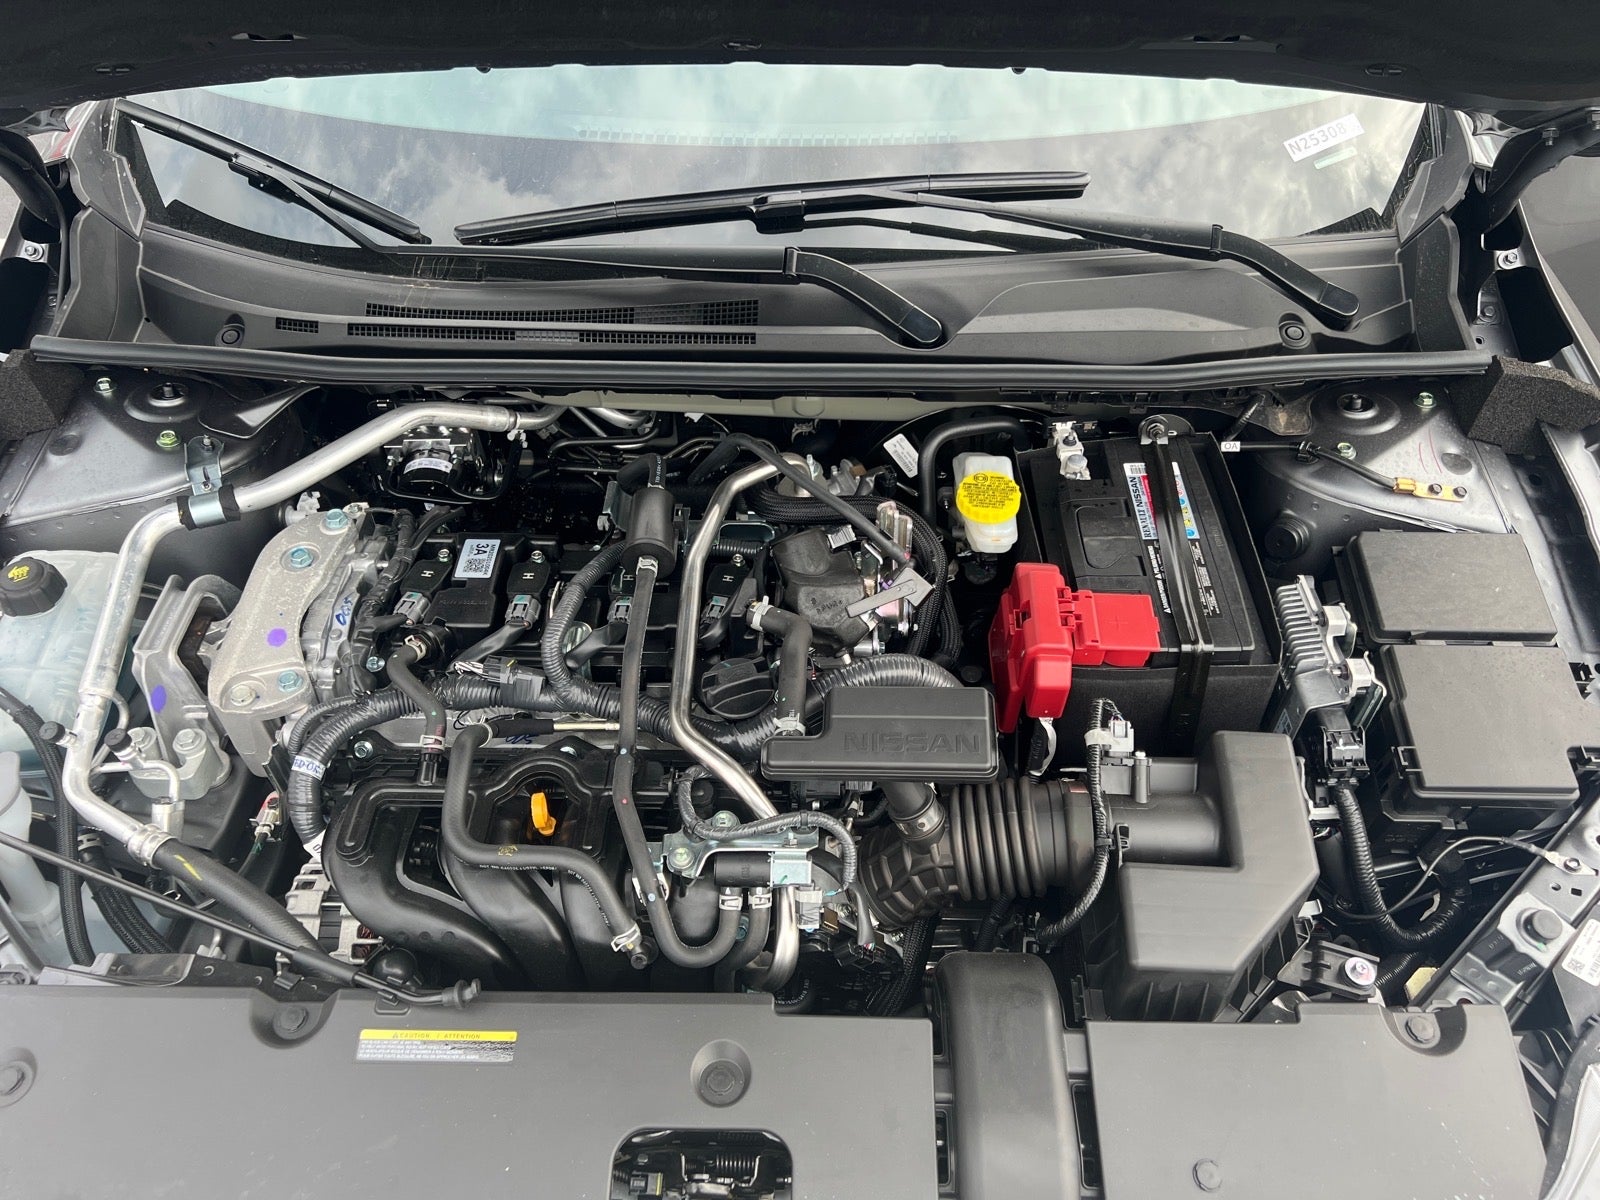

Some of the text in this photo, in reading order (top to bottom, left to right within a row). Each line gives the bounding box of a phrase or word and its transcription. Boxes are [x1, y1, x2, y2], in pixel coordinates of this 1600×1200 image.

[1129, 476, 1144, 508] NISSAN
[1137, 509, 1152, 538] RENAULT
[474, 543, 490, 556] 3A
[843, 731, 981, 754] NISSAN
